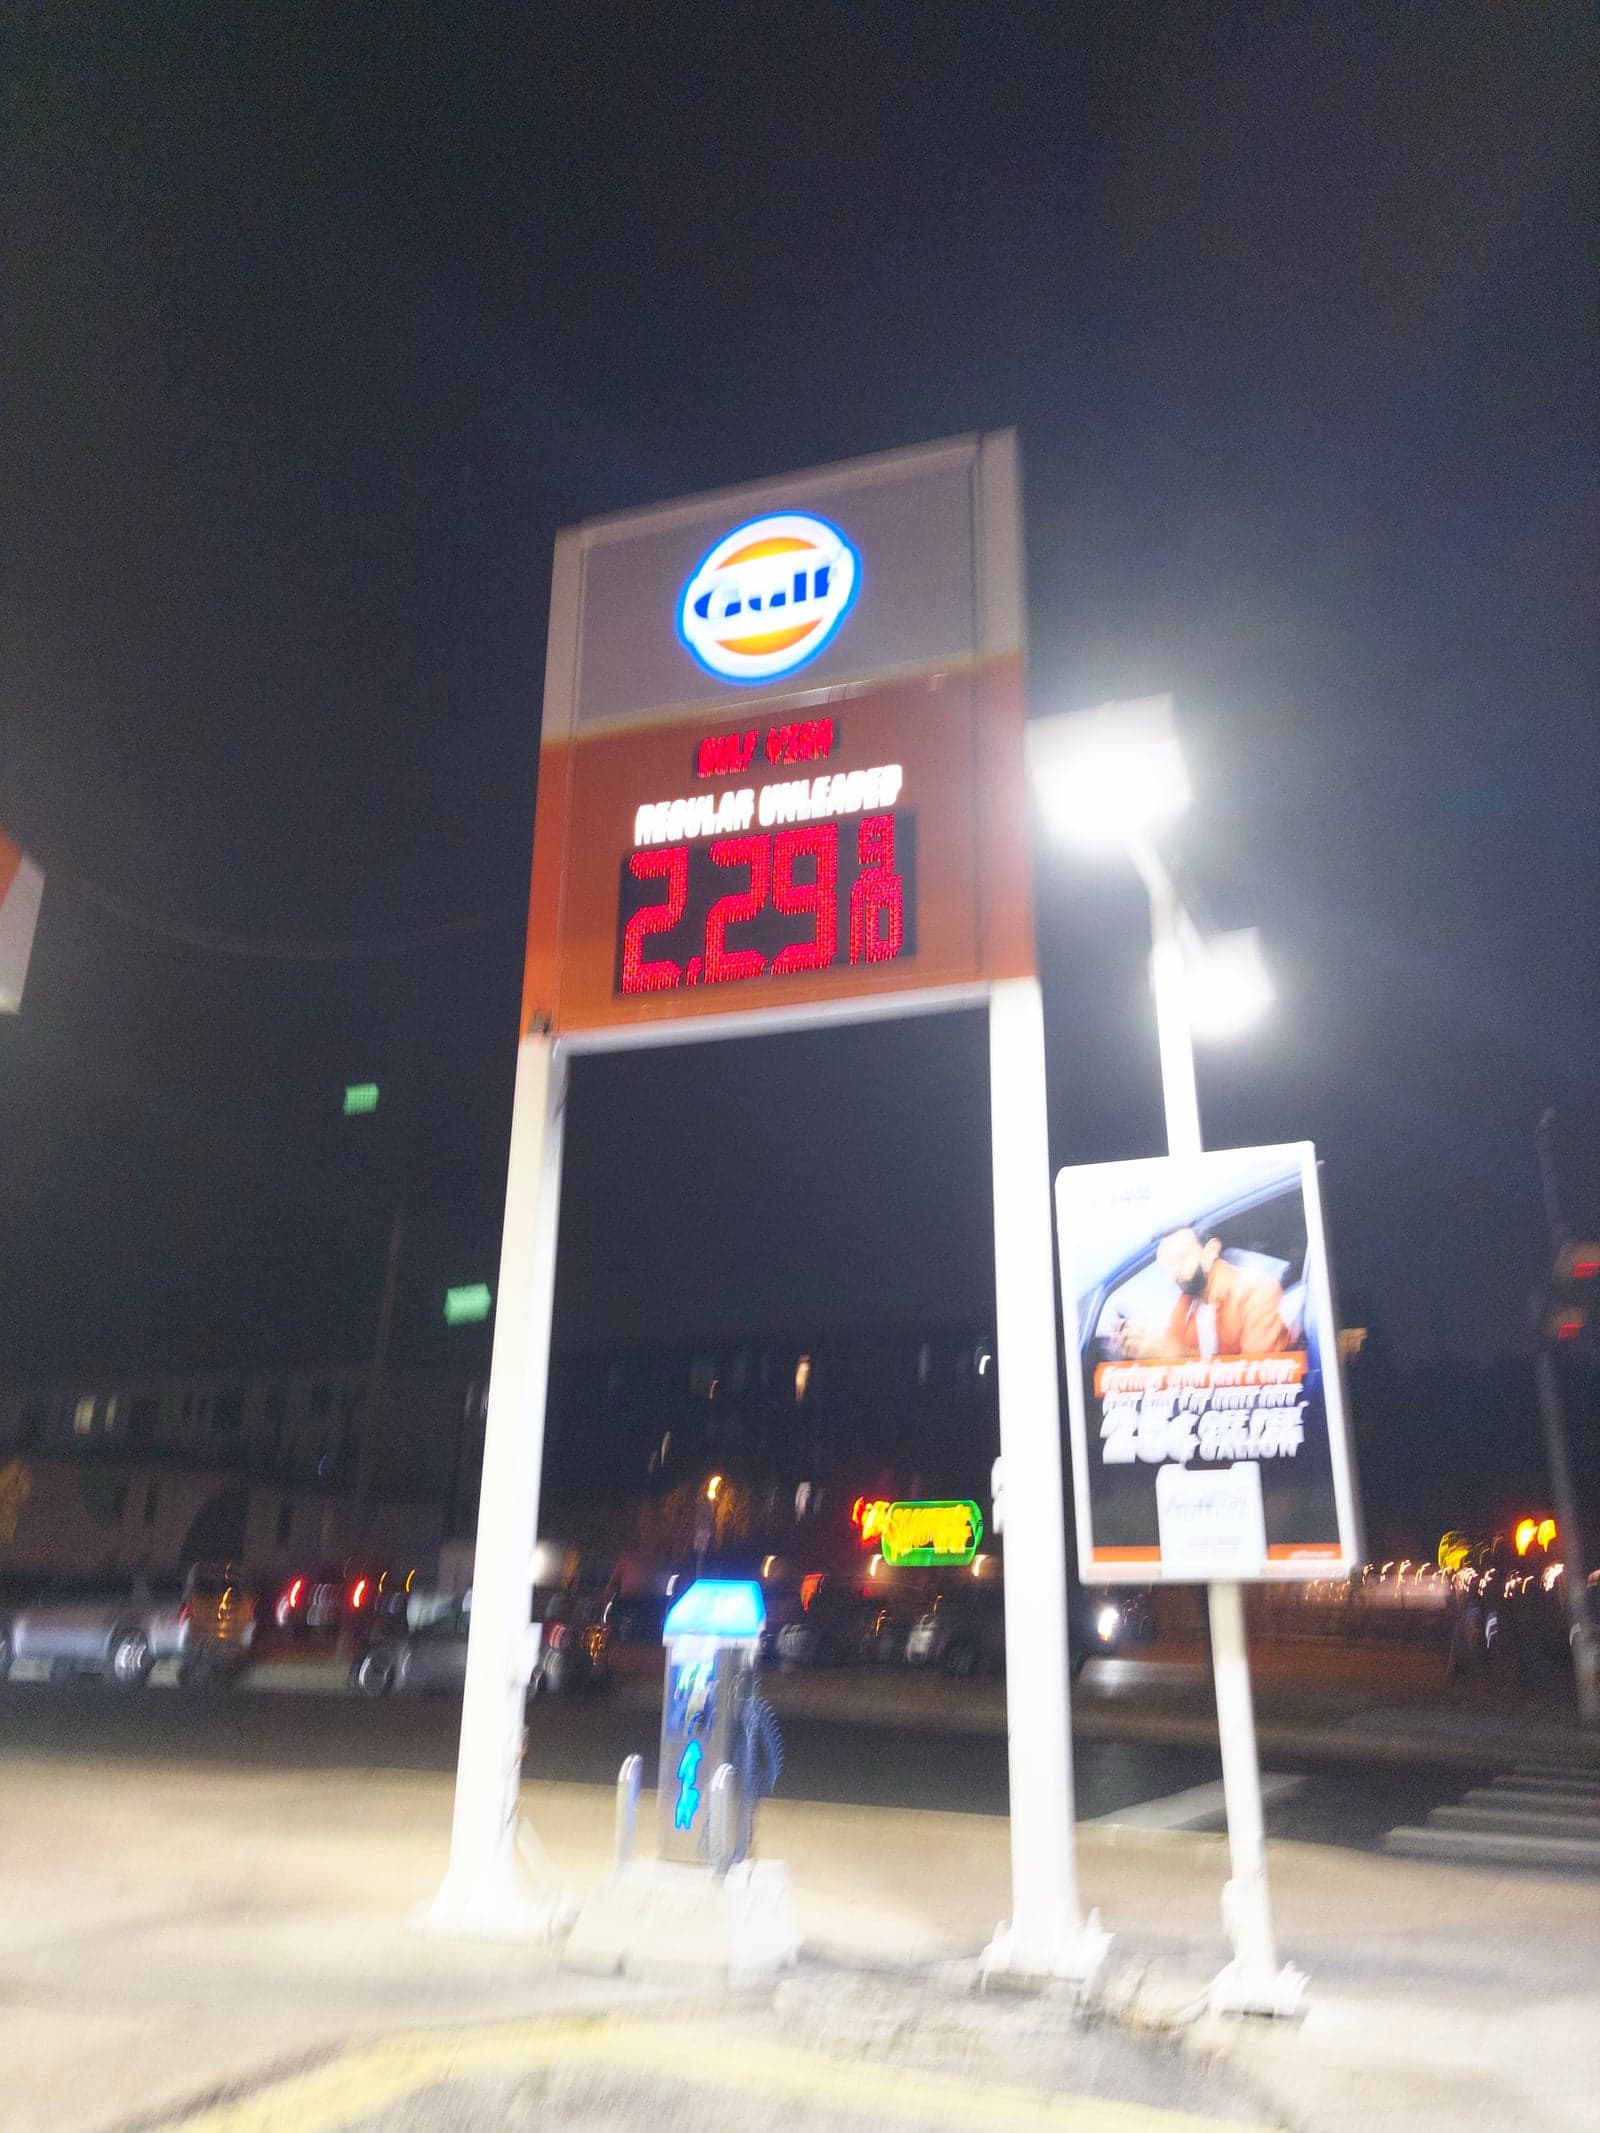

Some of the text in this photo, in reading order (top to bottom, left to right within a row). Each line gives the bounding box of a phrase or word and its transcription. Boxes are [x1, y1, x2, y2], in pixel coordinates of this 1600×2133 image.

[634, 764, 902, 846] REGULAR UNLEADED
[622, 823, 838, 994] 2.29
